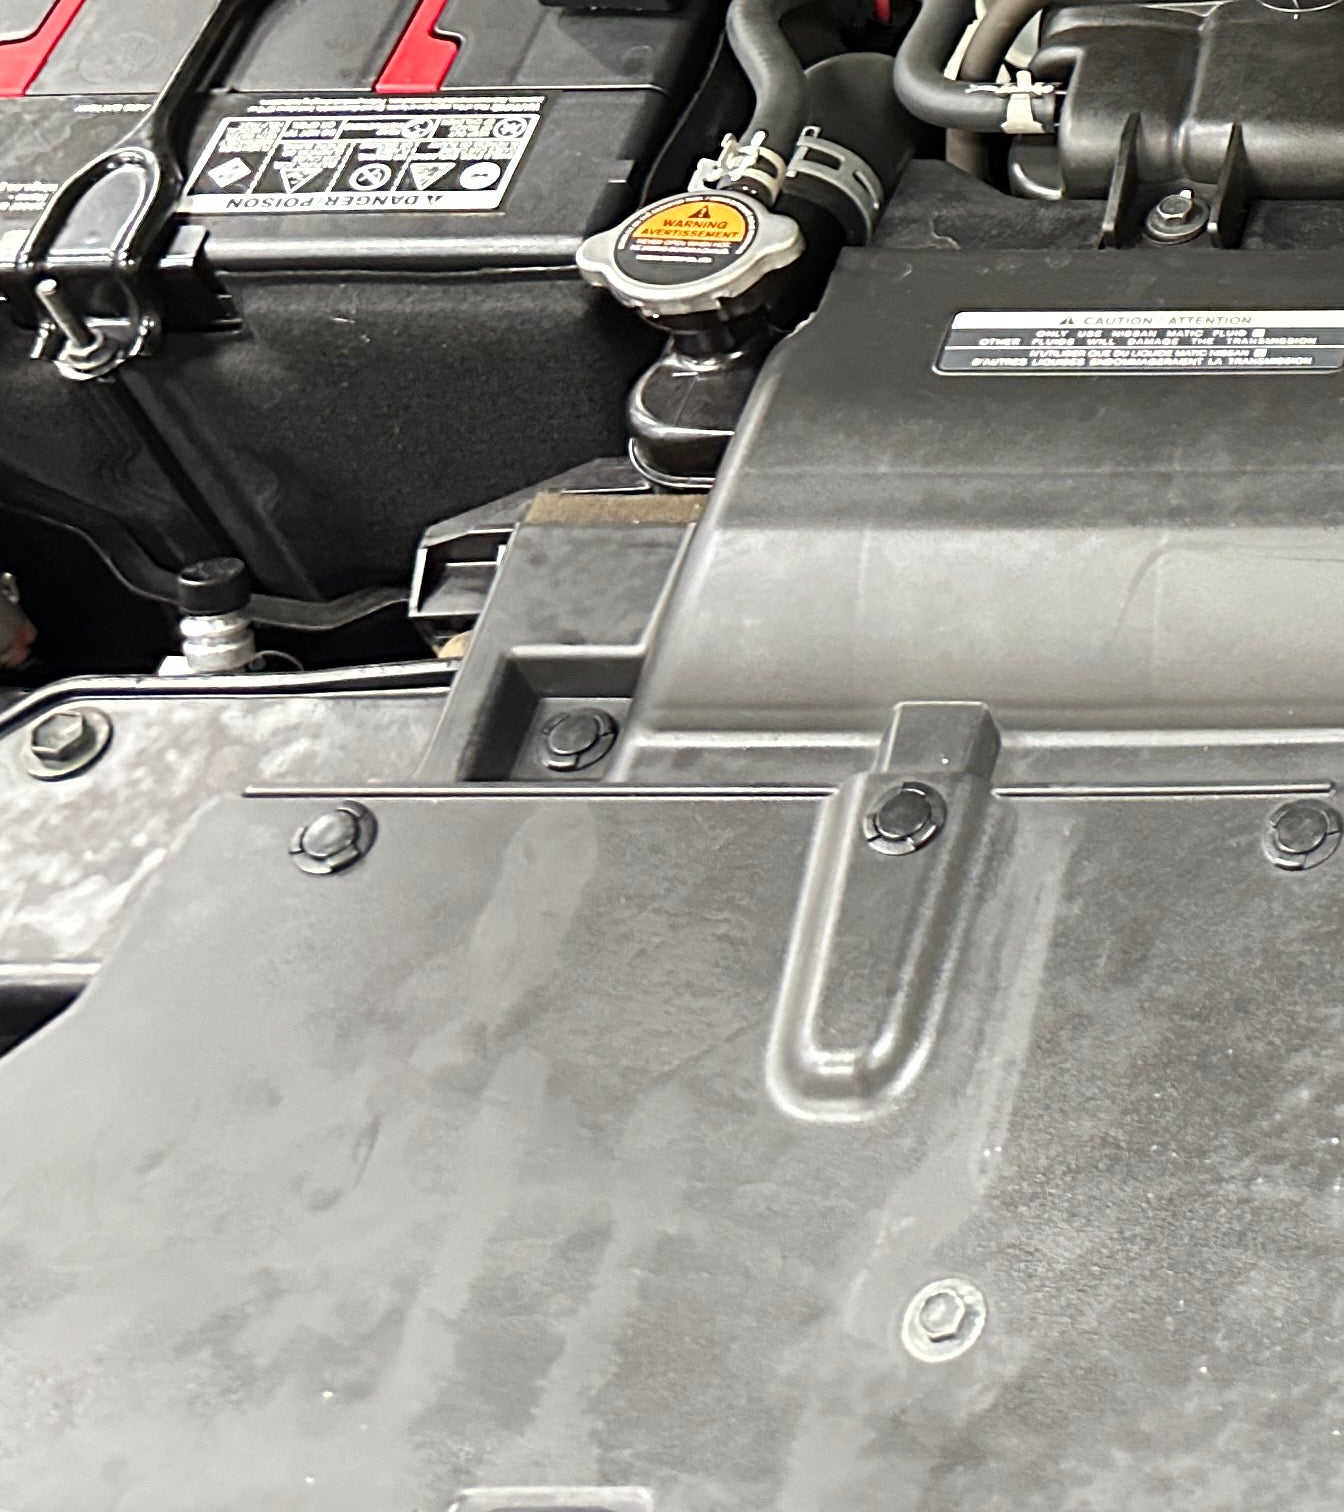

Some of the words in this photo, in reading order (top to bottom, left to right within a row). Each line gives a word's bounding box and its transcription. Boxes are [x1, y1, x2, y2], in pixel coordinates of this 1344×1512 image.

[663, 219, 729, 229] WARNING
[640, 228, 740, 239] AVERTISSEMENT
[1083, 316, 1153, 325] CAUTION
[1168, 316, 1252, 325] ATTENTION
[1035, 330, 1069, 338] ONLY
[1077, 330, 1103, 338] USE
[1111, 330, 1157, 338] NISSAN
[1166, 329, 1204, 338] MATIC
[1212, 329, 1247, 337] FLUID
[978, 338, 1021, 346] OTHER
[1031, 338, 1075, 346] FLUIDS
[1086, 338, 1116, 346] WILL
[1127, 338, 1179, 346] DAMAGE
[1207, 357, 1223, 365] LA
